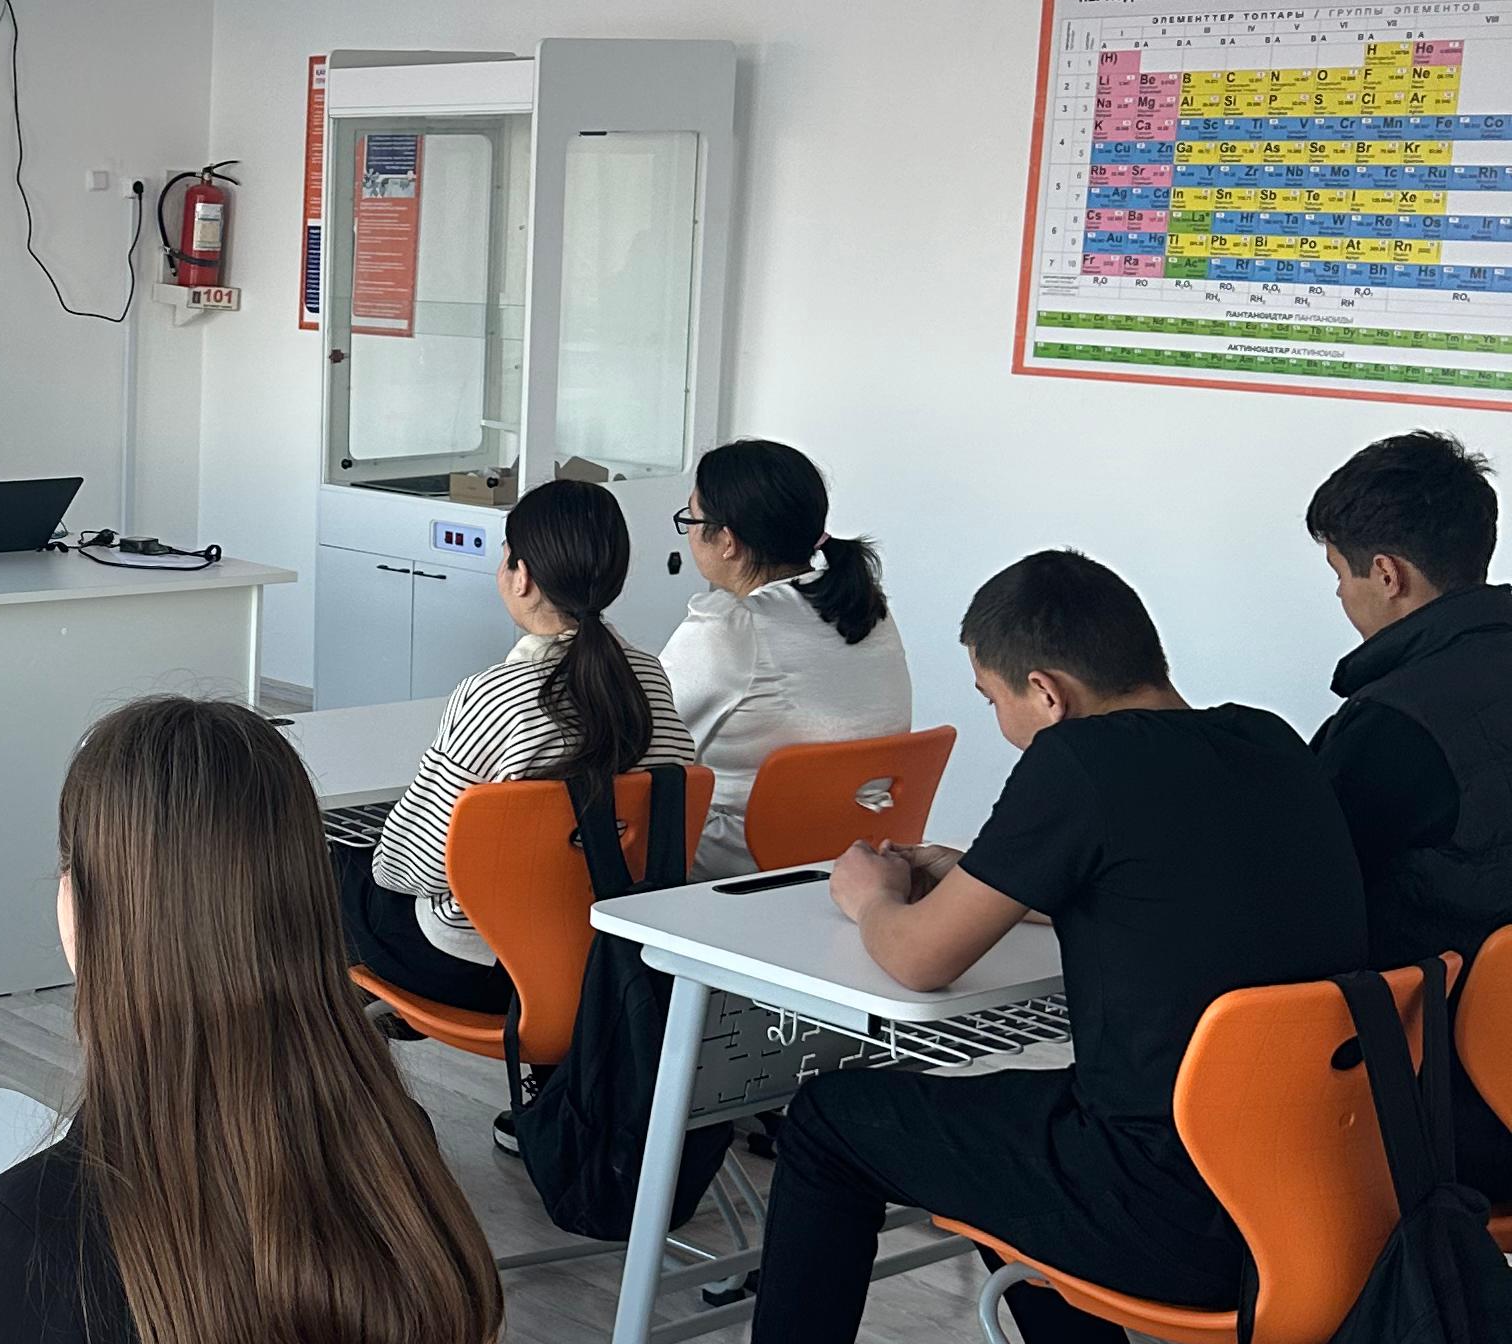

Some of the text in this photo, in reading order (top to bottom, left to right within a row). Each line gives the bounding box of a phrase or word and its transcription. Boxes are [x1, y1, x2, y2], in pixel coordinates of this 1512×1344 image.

[1152, 3, 1481, 25] ЭЛЕМЕНТТЕР ТОПТАРЫ ГРУППЫ ЭЛЕМЕНТОВ
[1367, 43, 1434, 55] H He
[1101, 51, 1118, 65] (H)
[1099, 68, 1431, 86] Li Be B C N O F Ne
[1096, 97, 1112, 109] Na
[1138, 97, 1156, 110] Mg
[1268, 95, 1278, 105] P
[1314, 94, 1324, 105] S
[1409, 93, 1427, 104] Ar
[1094, 117, 1504, 131] K Ca Sc V Cr Mn Fe Co
[1114, 142, 1421, 154] Cu Zn Ga Ge As Se Br Kr
[1090, 165, 1106, 176] Rb
[1131, 165, 1145, 176] Sr
[1330, 167, 1350, 178] Mo
[1111, 188, 1417, 203] Ag Cd In Sn Sb Te Xe
[1086, 209, 1101, 220] Cs
[1128, 210, 1143, 221] Ba
[1106, 233, 1122, 243] Au
[1211, 236, 1227, 247] Pb
[1255, 237, 1267, 247] Bi
[1299, 238, 1317, 249] Po
[1345, 239, 1360, 250] At
[1394, 240, 1412, 252] Rn
[1123, 255, 1139, 266] Ra
[203, 289, 233, 304] 101
